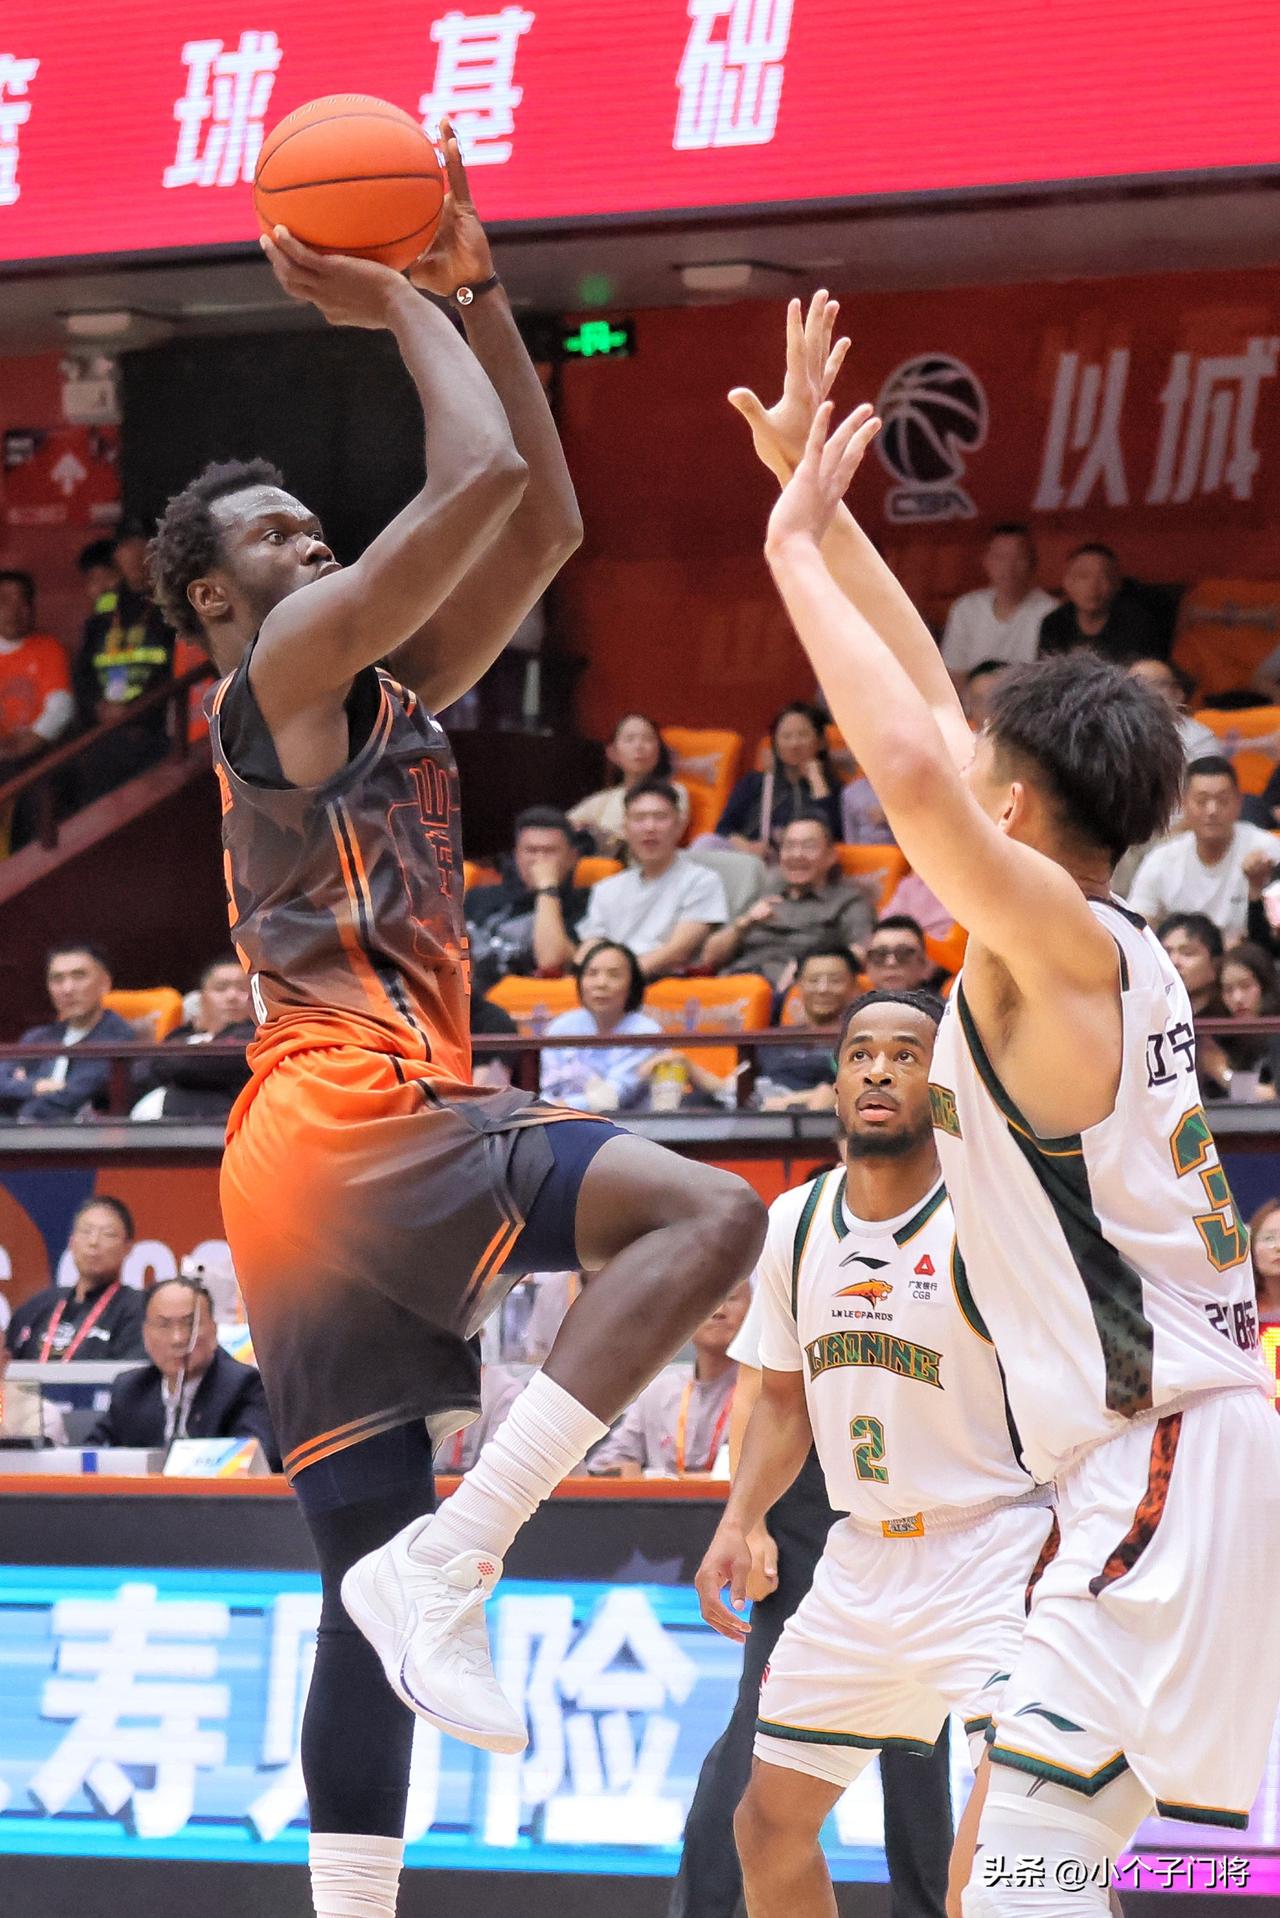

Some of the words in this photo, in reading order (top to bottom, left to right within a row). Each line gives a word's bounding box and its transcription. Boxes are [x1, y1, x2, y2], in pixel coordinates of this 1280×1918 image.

[1146, 1022, 1195, 1088] 辽宁
[908, 1280, 938, 1292] 广发银行
[912, 1291, 931, 1300] CGB
[831, 1309, 843, 1317] LN
[844, 1310, 893, 1321] LEOPARDS
[804, 1330, 945, 1391] LIAONING
[849, 1415, 889, 1484] 2
